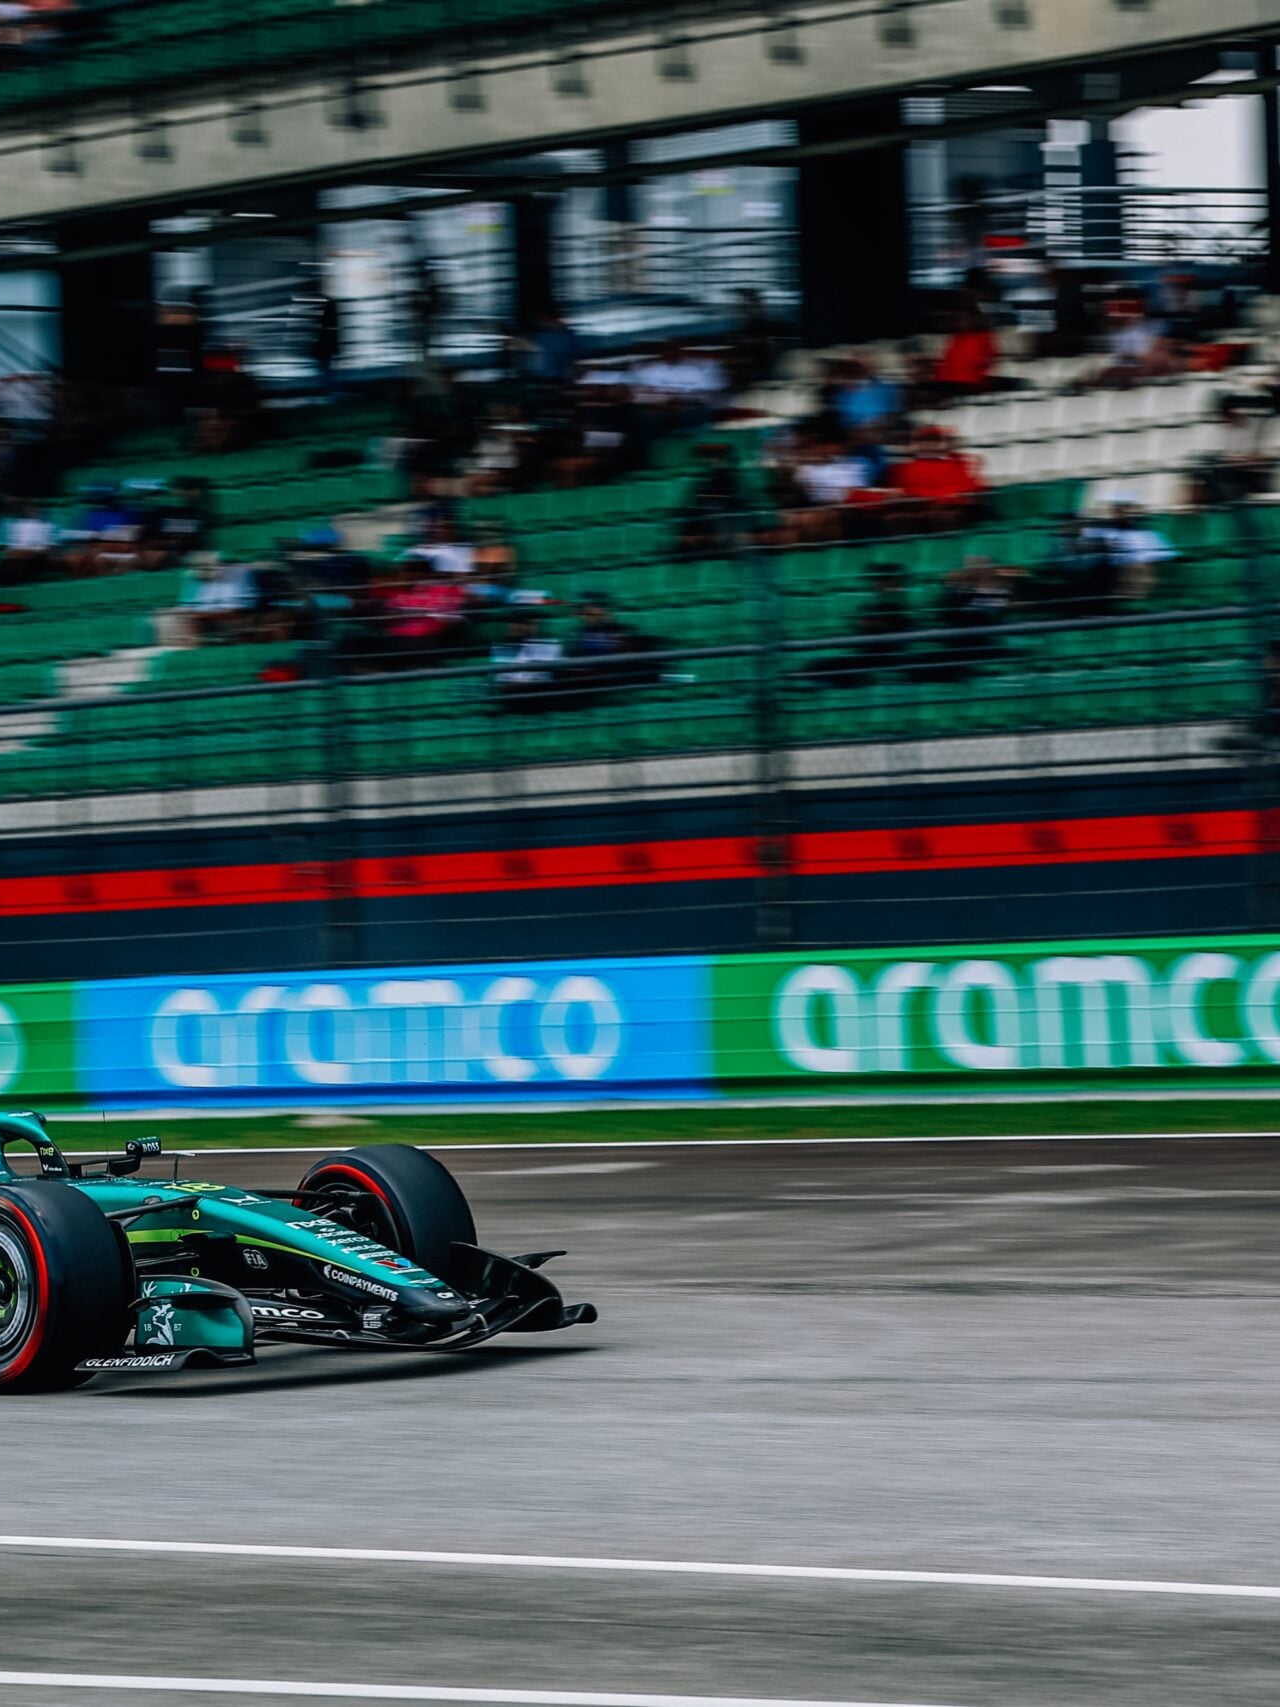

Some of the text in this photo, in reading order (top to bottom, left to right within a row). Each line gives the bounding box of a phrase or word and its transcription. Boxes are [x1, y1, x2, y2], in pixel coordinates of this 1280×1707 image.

[152, 972, 623, 1090] aramco
[141, 1142, 160, 1152] BOSS
[331, 1269, 400, 1302] COINPAYMENTS
[144, 1323, 183, 1332] 18 87
[85, 1354, 175, 1368] GLENFIDDICH
